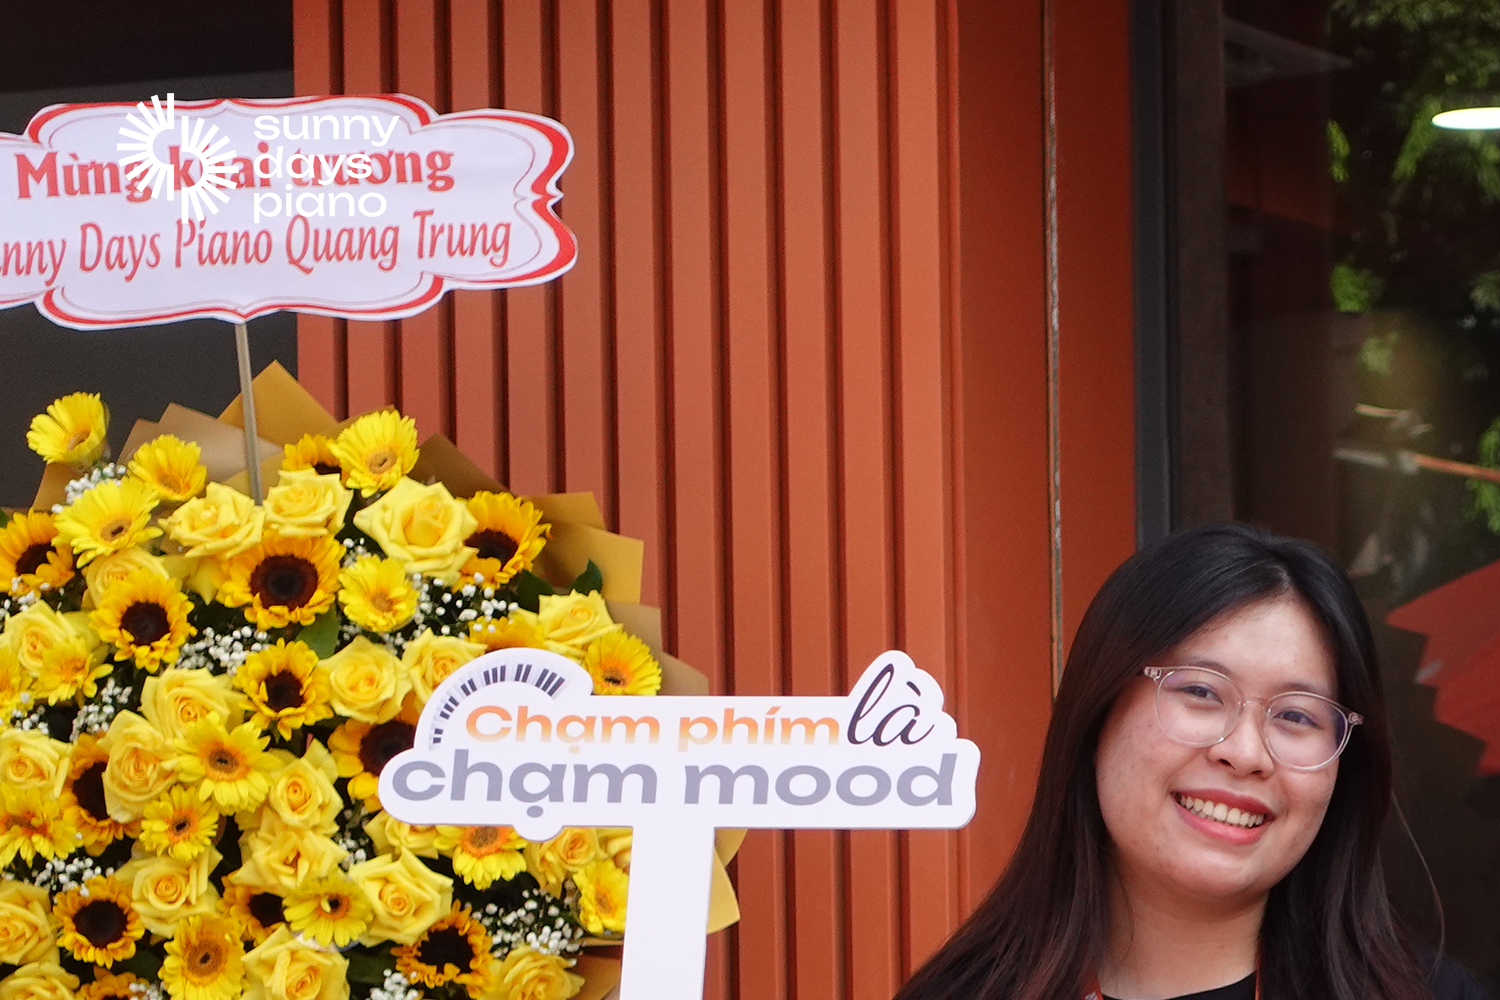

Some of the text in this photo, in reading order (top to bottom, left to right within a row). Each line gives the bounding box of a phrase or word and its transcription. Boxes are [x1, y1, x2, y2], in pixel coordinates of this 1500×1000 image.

[0, 208, 511, 287] nny Days Piano Quang Trung
[465, 662, 935, 755] Chạm phím là
[391, 748, 958, 819] chạm mood
